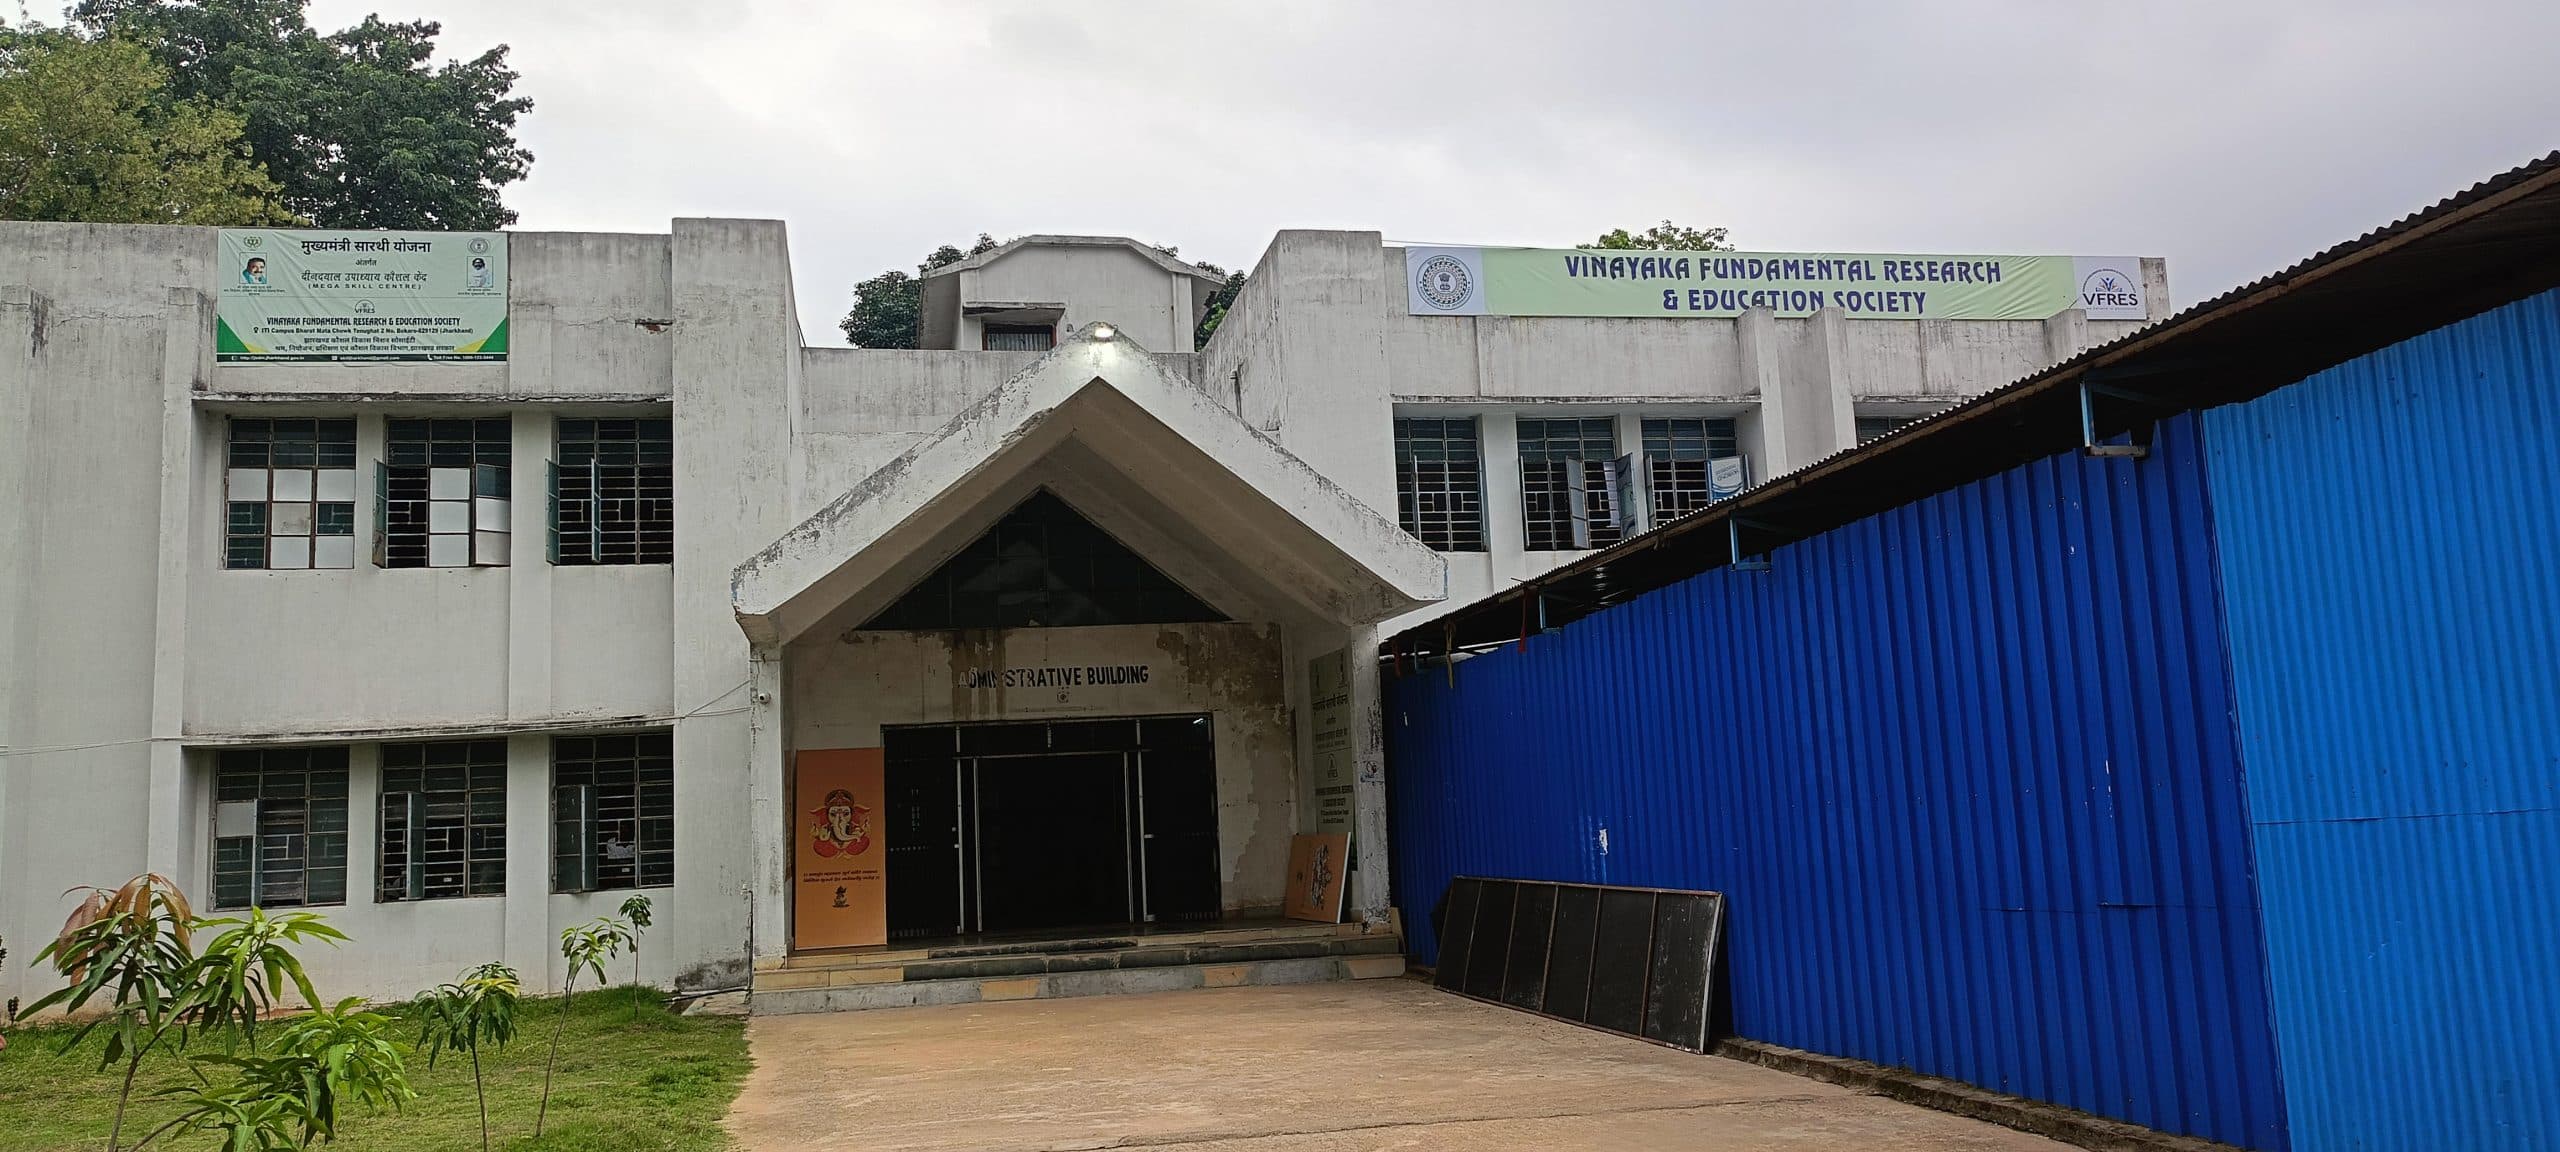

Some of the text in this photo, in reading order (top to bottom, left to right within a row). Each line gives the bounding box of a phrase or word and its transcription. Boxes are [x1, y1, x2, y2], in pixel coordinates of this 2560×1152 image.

[301, 238, 432, 255] मुख्यमंत्री सारथी योजना
[355, 258, 377, 267] अंतर्गत
[1565, 256, 2001, 284] VINAYAKA FUNDAMENTAL RESEARCH
[345, 273, 381, 282] उपाध्याय
[384, 271, 410, 282] कौशल
[1663, 290, 1926, 315] & EDUCATION SOCIETY
[2083, 293, 2138, 306] VFRES
[266, 317, 460, 326] VINAYAKA FUNDAMENTAL RESEARCH & EDUCATION SOCIETY
[1087, 665, 1149, 685] BUILDING
